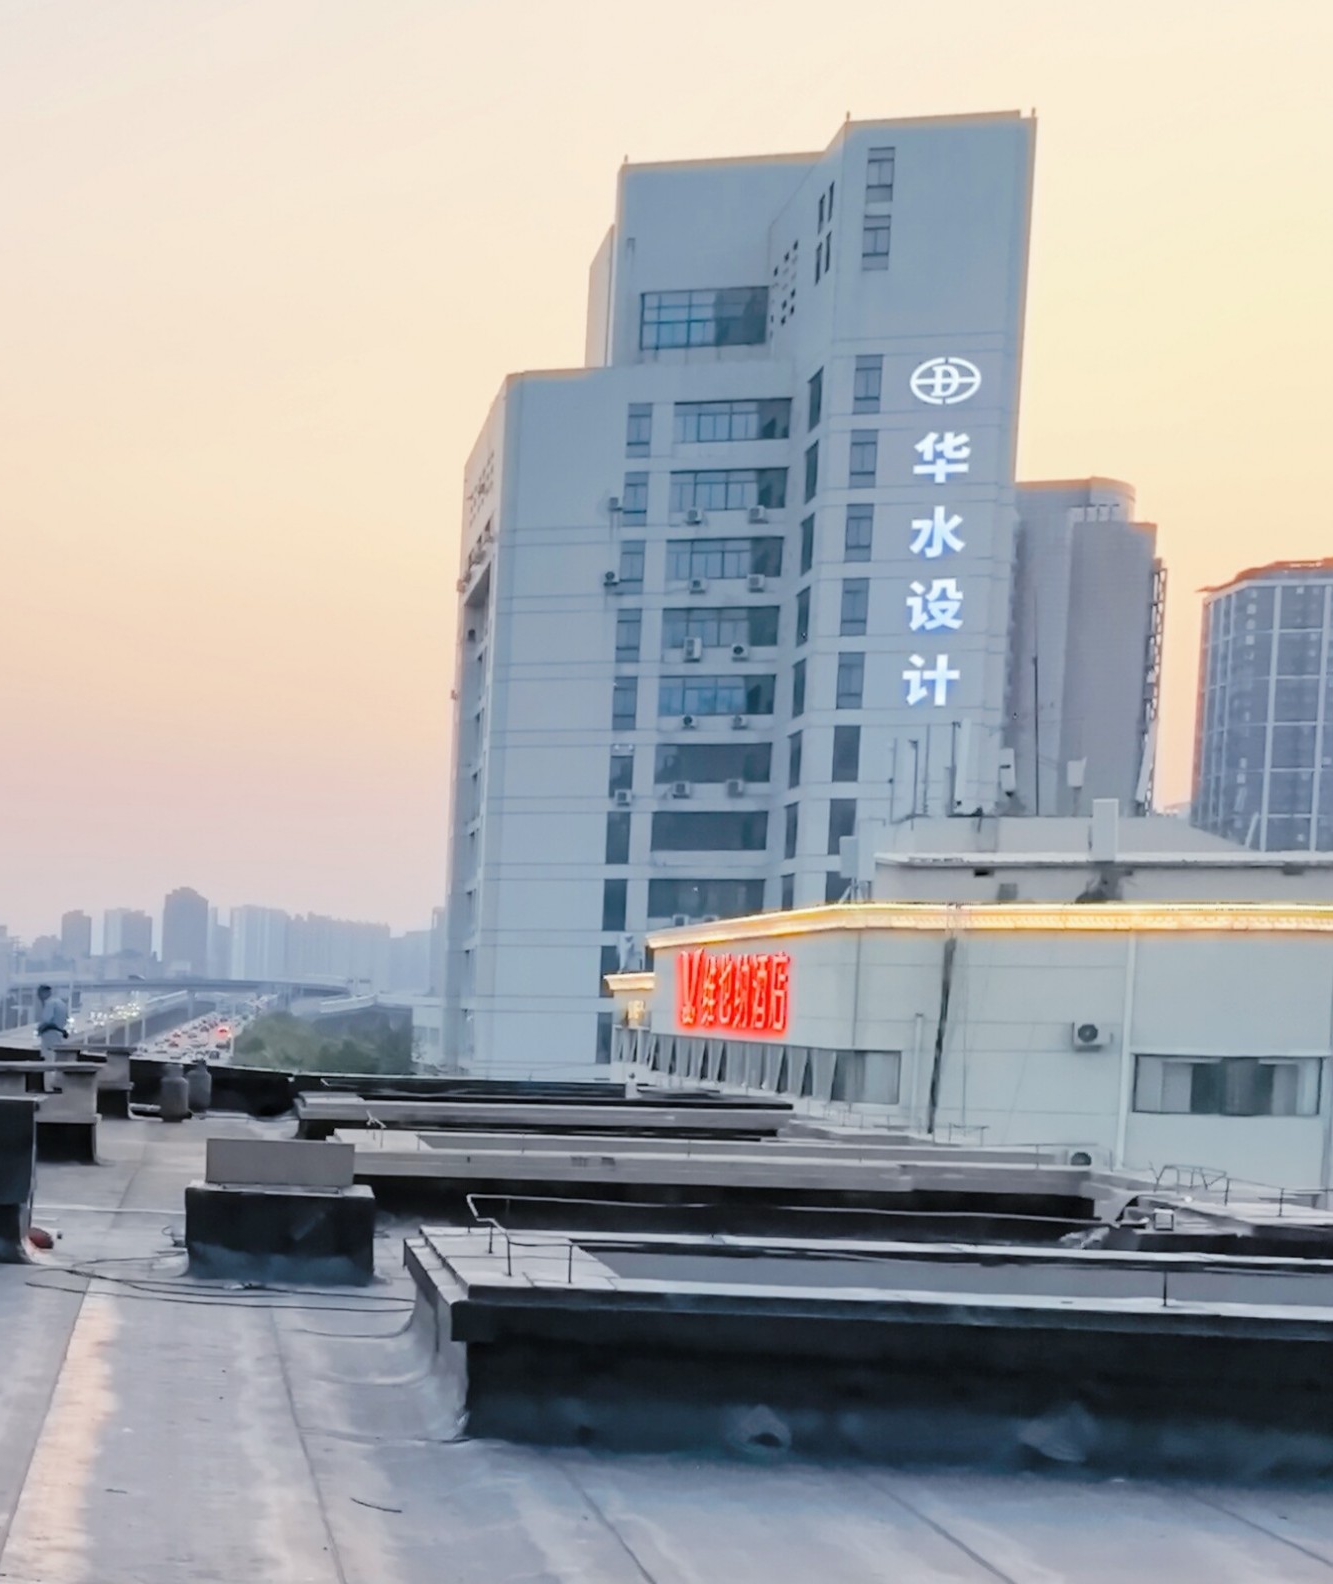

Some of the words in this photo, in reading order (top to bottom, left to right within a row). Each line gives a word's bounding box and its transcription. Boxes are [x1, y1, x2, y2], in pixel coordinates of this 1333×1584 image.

[902, 431, 971, 707] 华水设计
[700, 951, 791, 1031] 维也纳酒店
